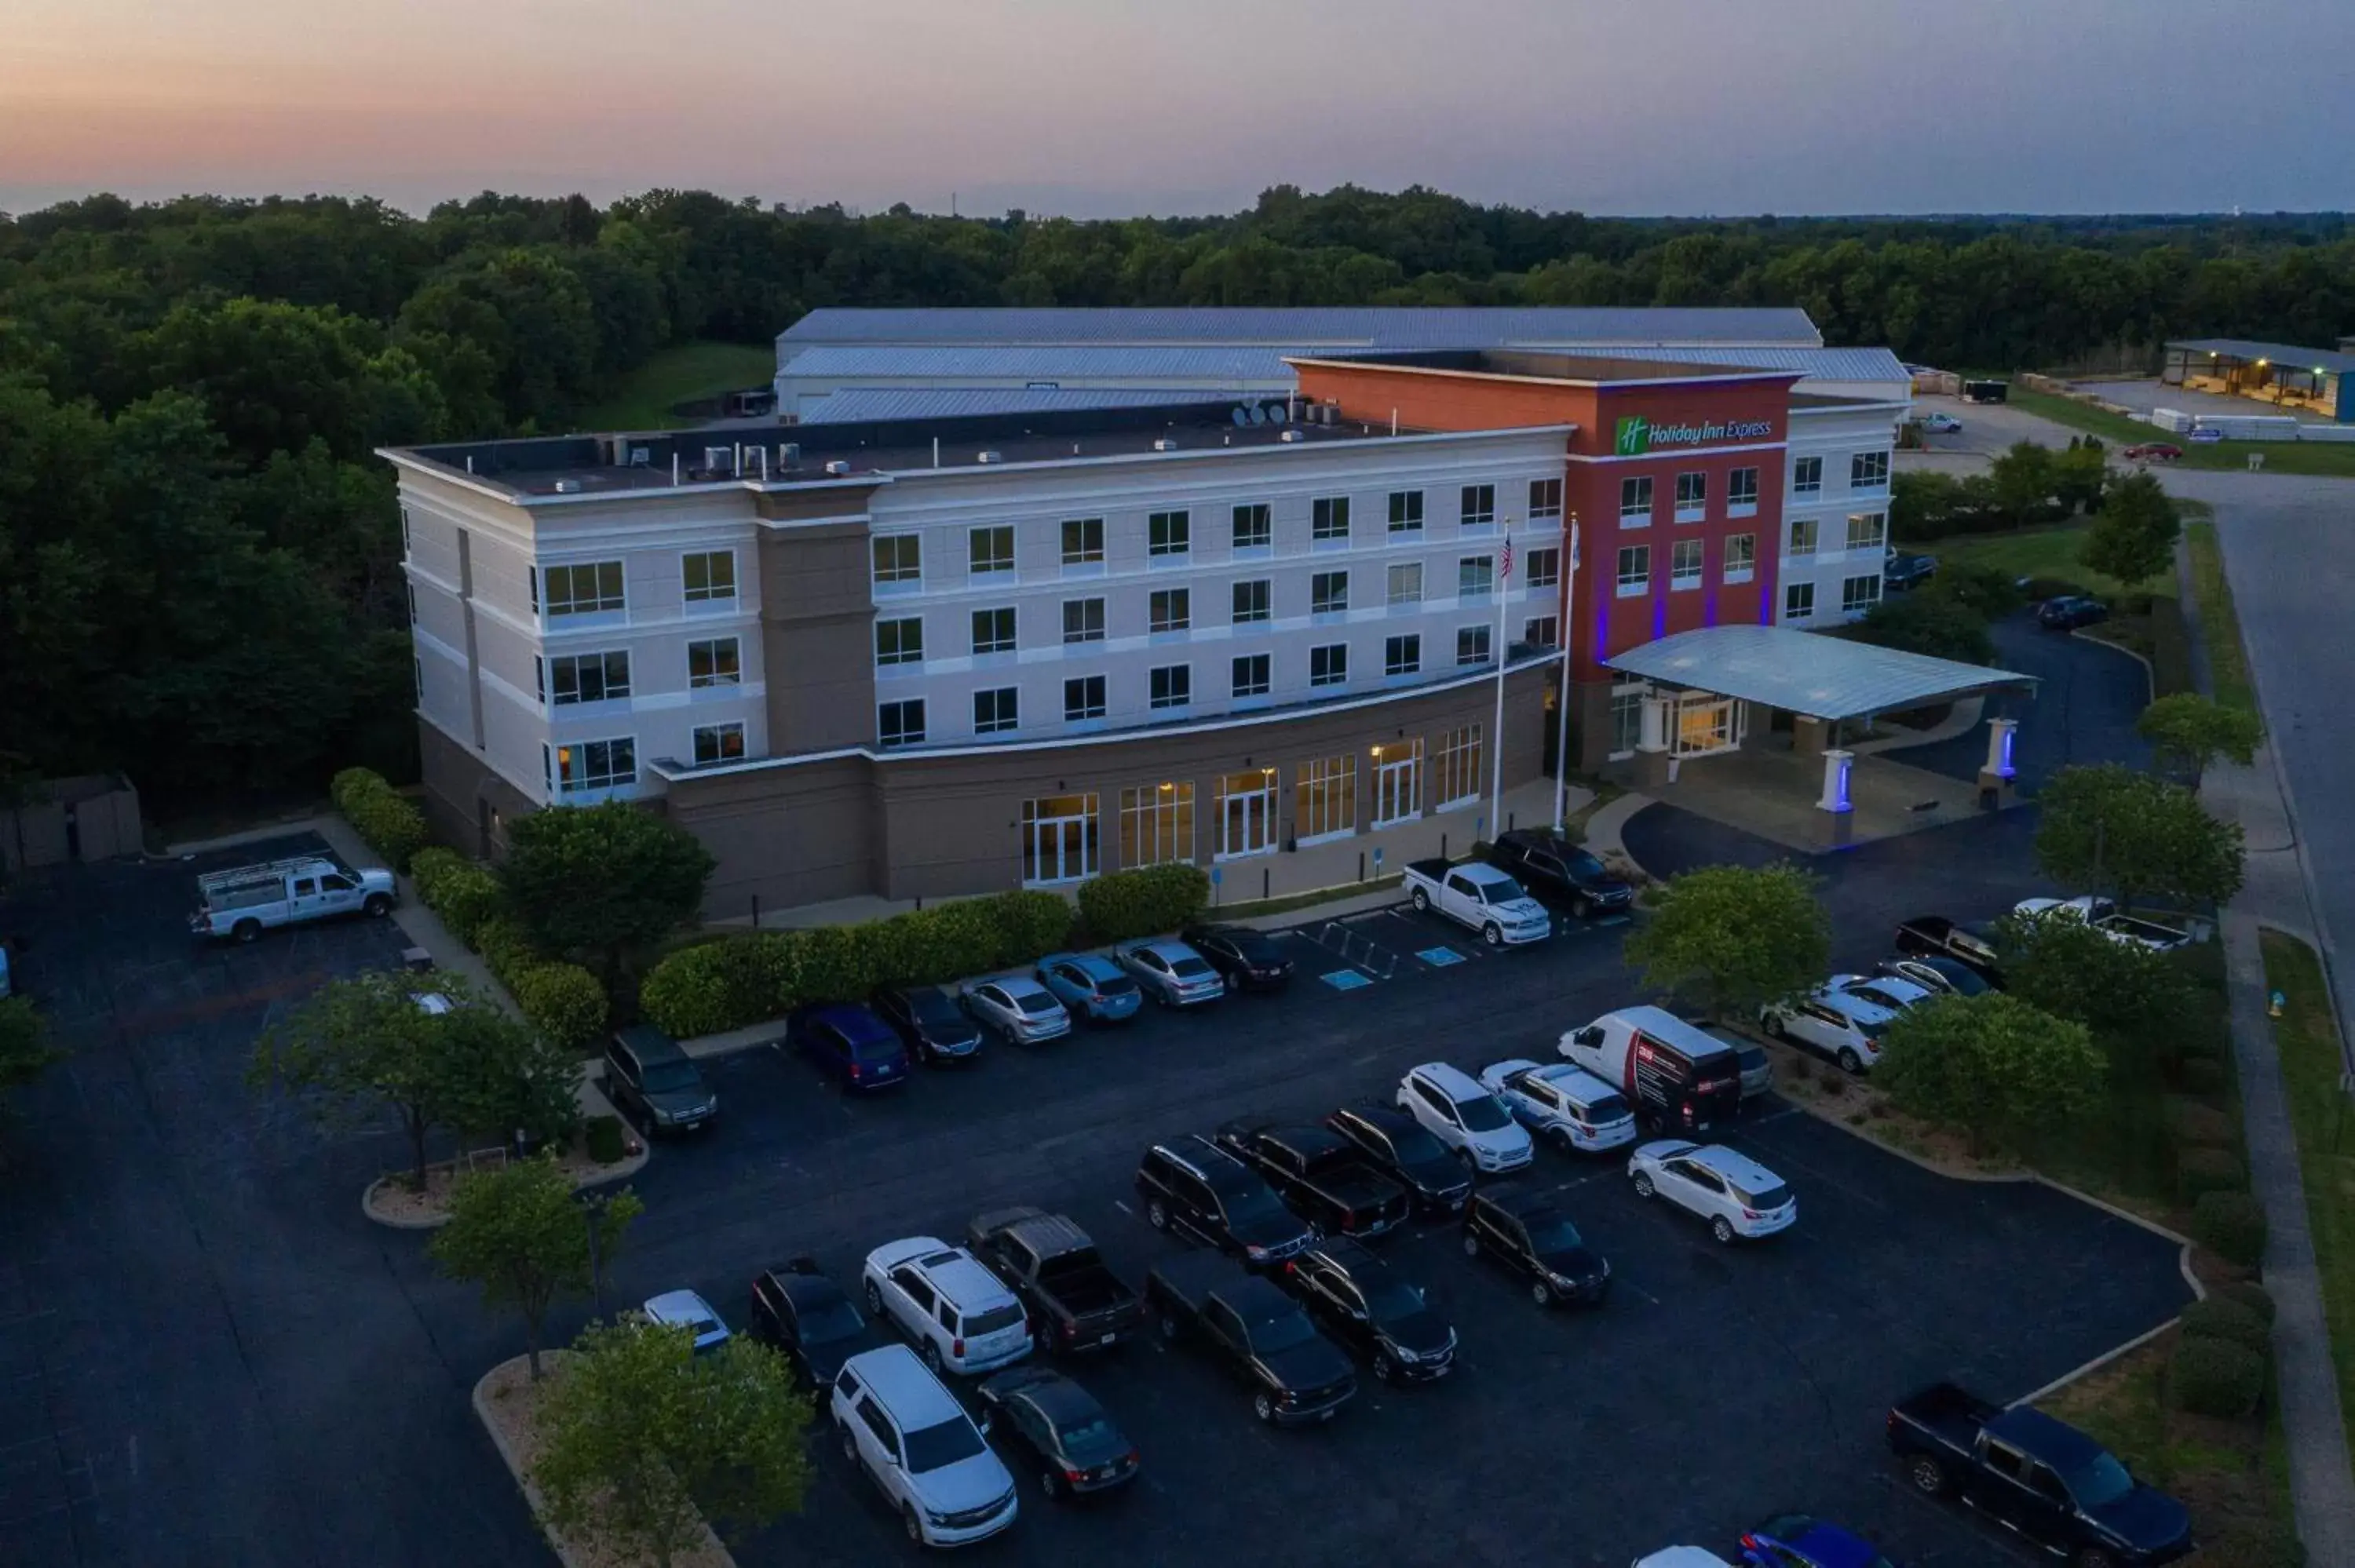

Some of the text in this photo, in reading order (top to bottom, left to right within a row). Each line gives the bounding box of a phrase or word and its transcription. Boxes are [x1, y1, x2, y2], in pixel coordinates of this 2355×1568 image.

[1648, 420, 1772, 445] Holiday Inn Express
